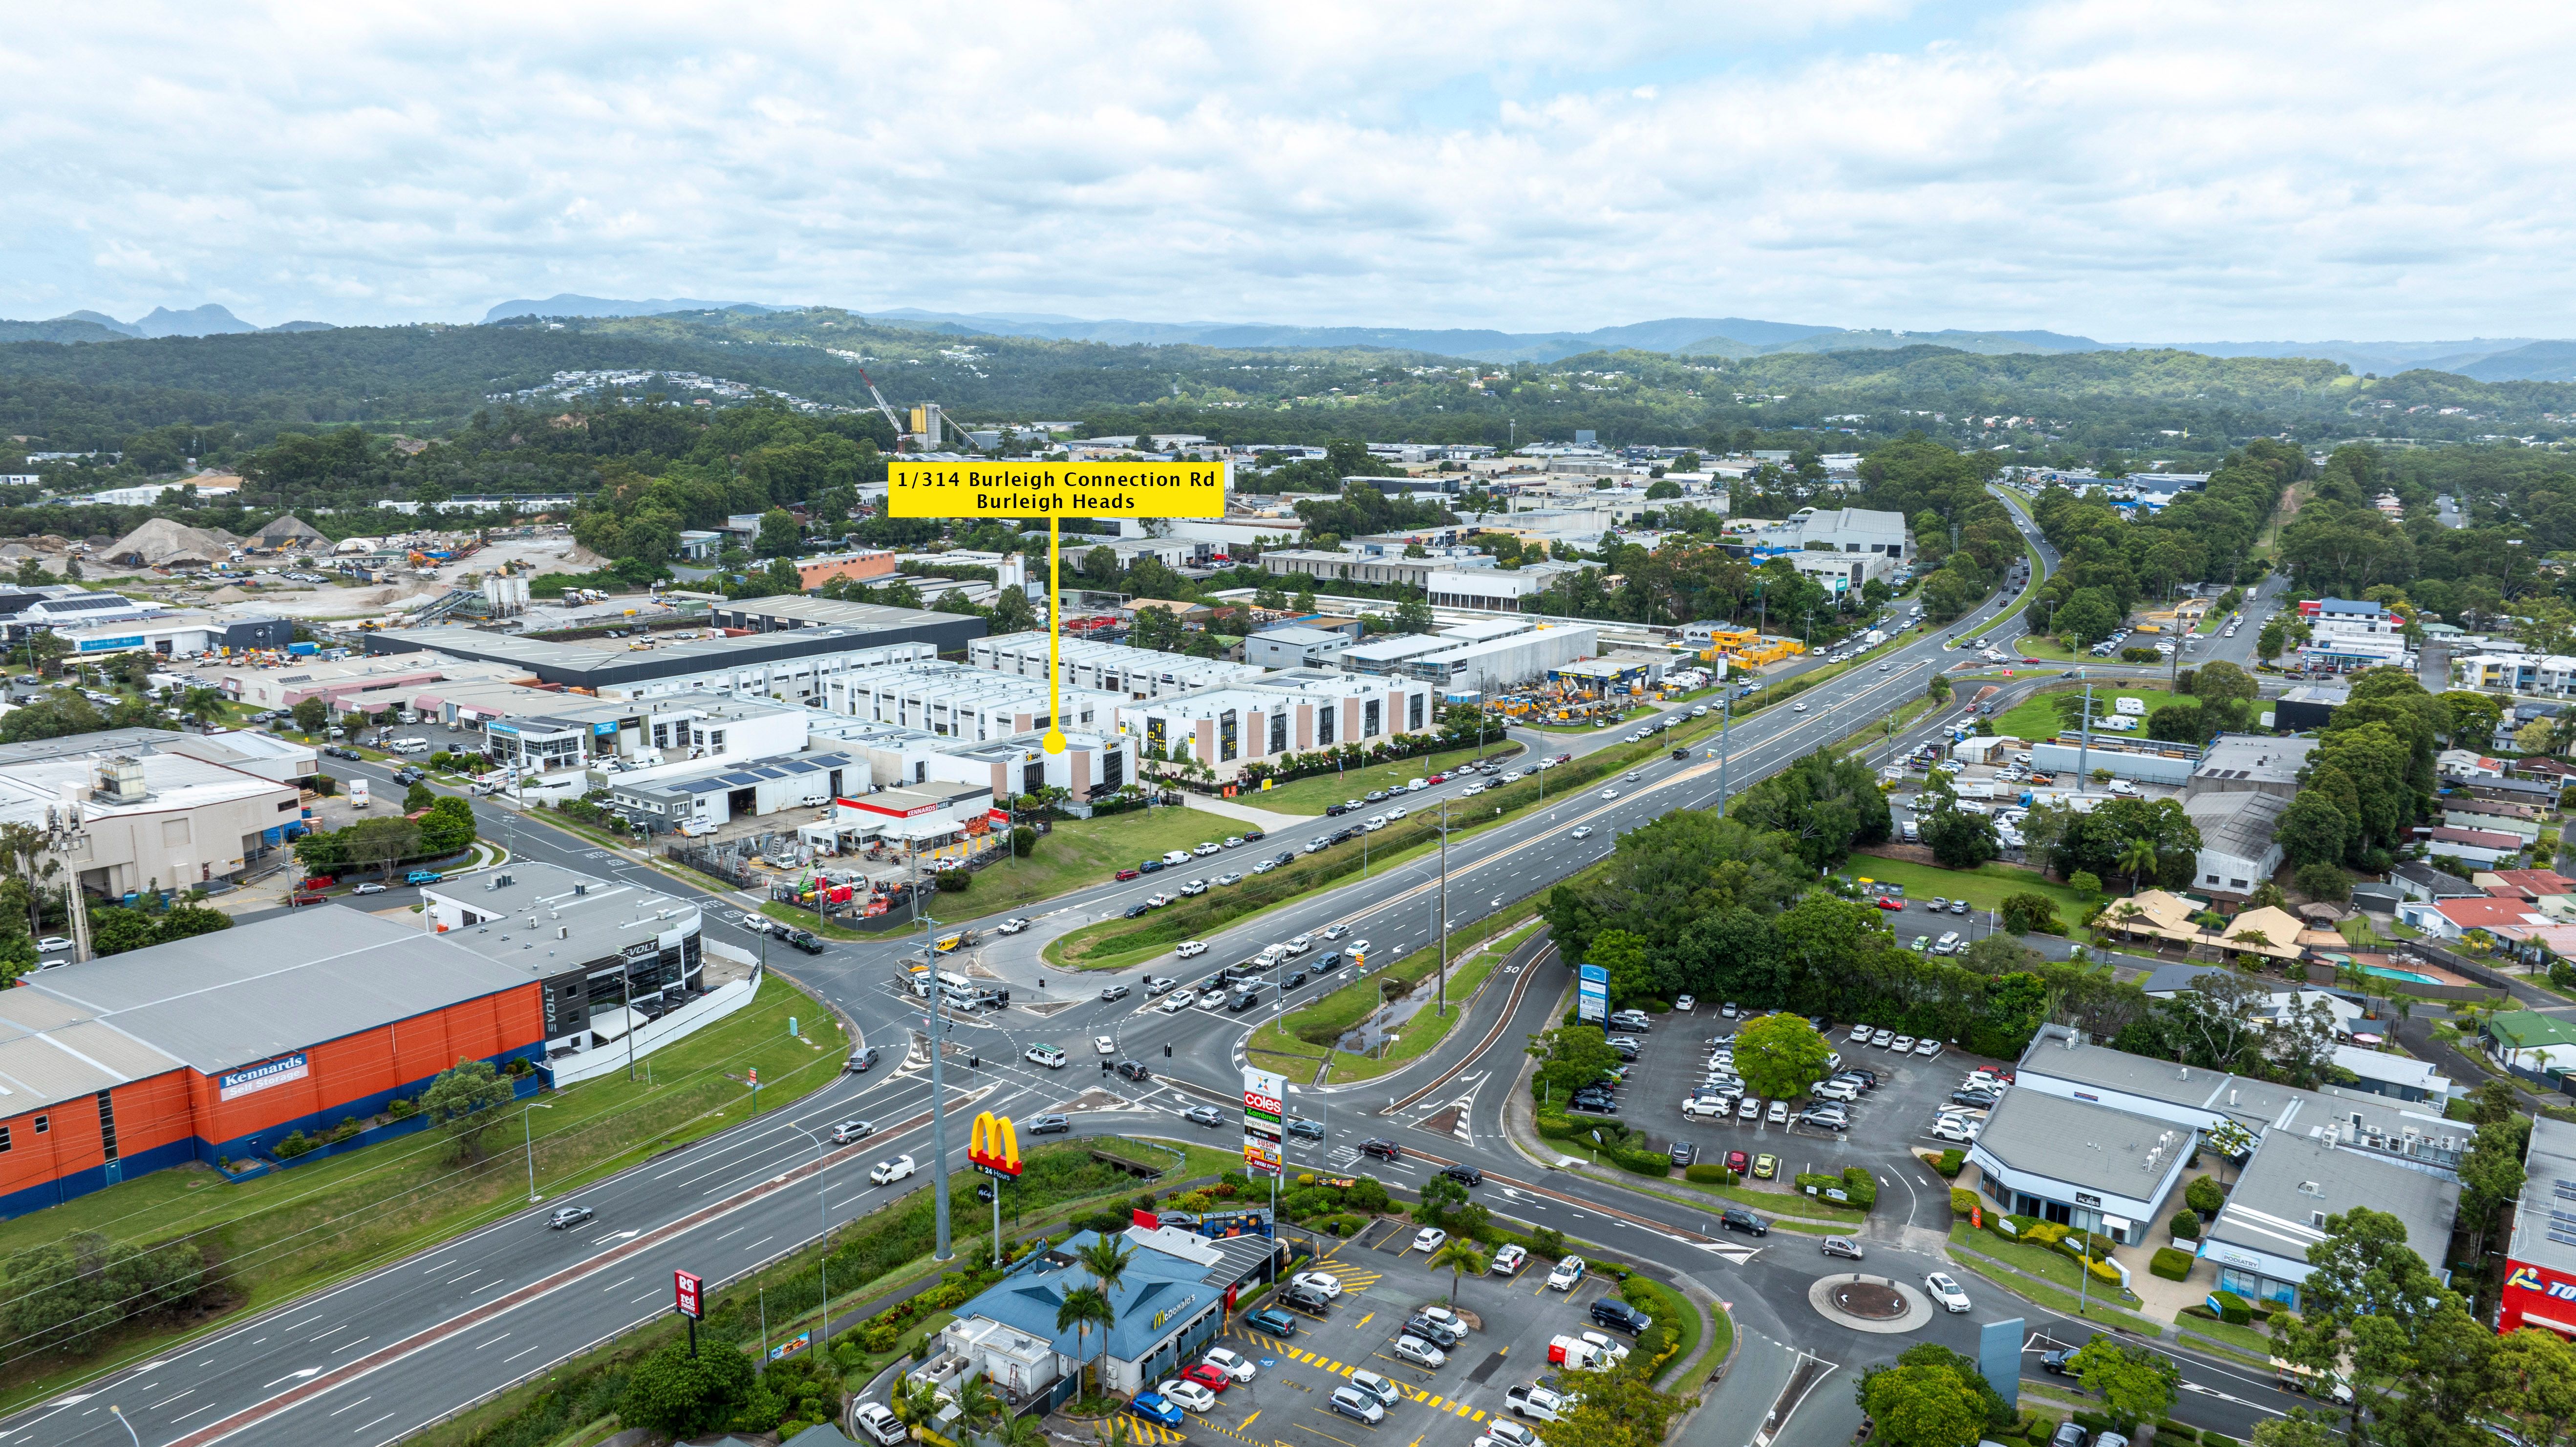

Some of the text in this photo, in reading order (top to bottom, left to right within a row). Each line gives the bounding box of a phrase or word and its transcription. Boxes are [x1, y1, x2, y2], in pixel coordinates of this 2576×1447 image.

[907, 801, 949, 816] KENNARDS HIRE
[545, 984, 557, 1032] EVOLT
[225, 1056, 302, 1087] Kennards
[230, 1070, 300, 1096] Self Storage
[1245, 1094, 1281, 1113] coles
[1246, 1107, 1280, 1123] Zambrero
[1245, 1118, 1281, 1132] Sogno Italiano
[1257, 1139, 1276, 1149] SUSHI
[994, 1169, 1010, 1181] Hours
[2224, 1255, 2258, 1268] PODIATRY
[680, 1294, 695, 1307] red
[1154, 1294, 1196, 1330] McDonald's
